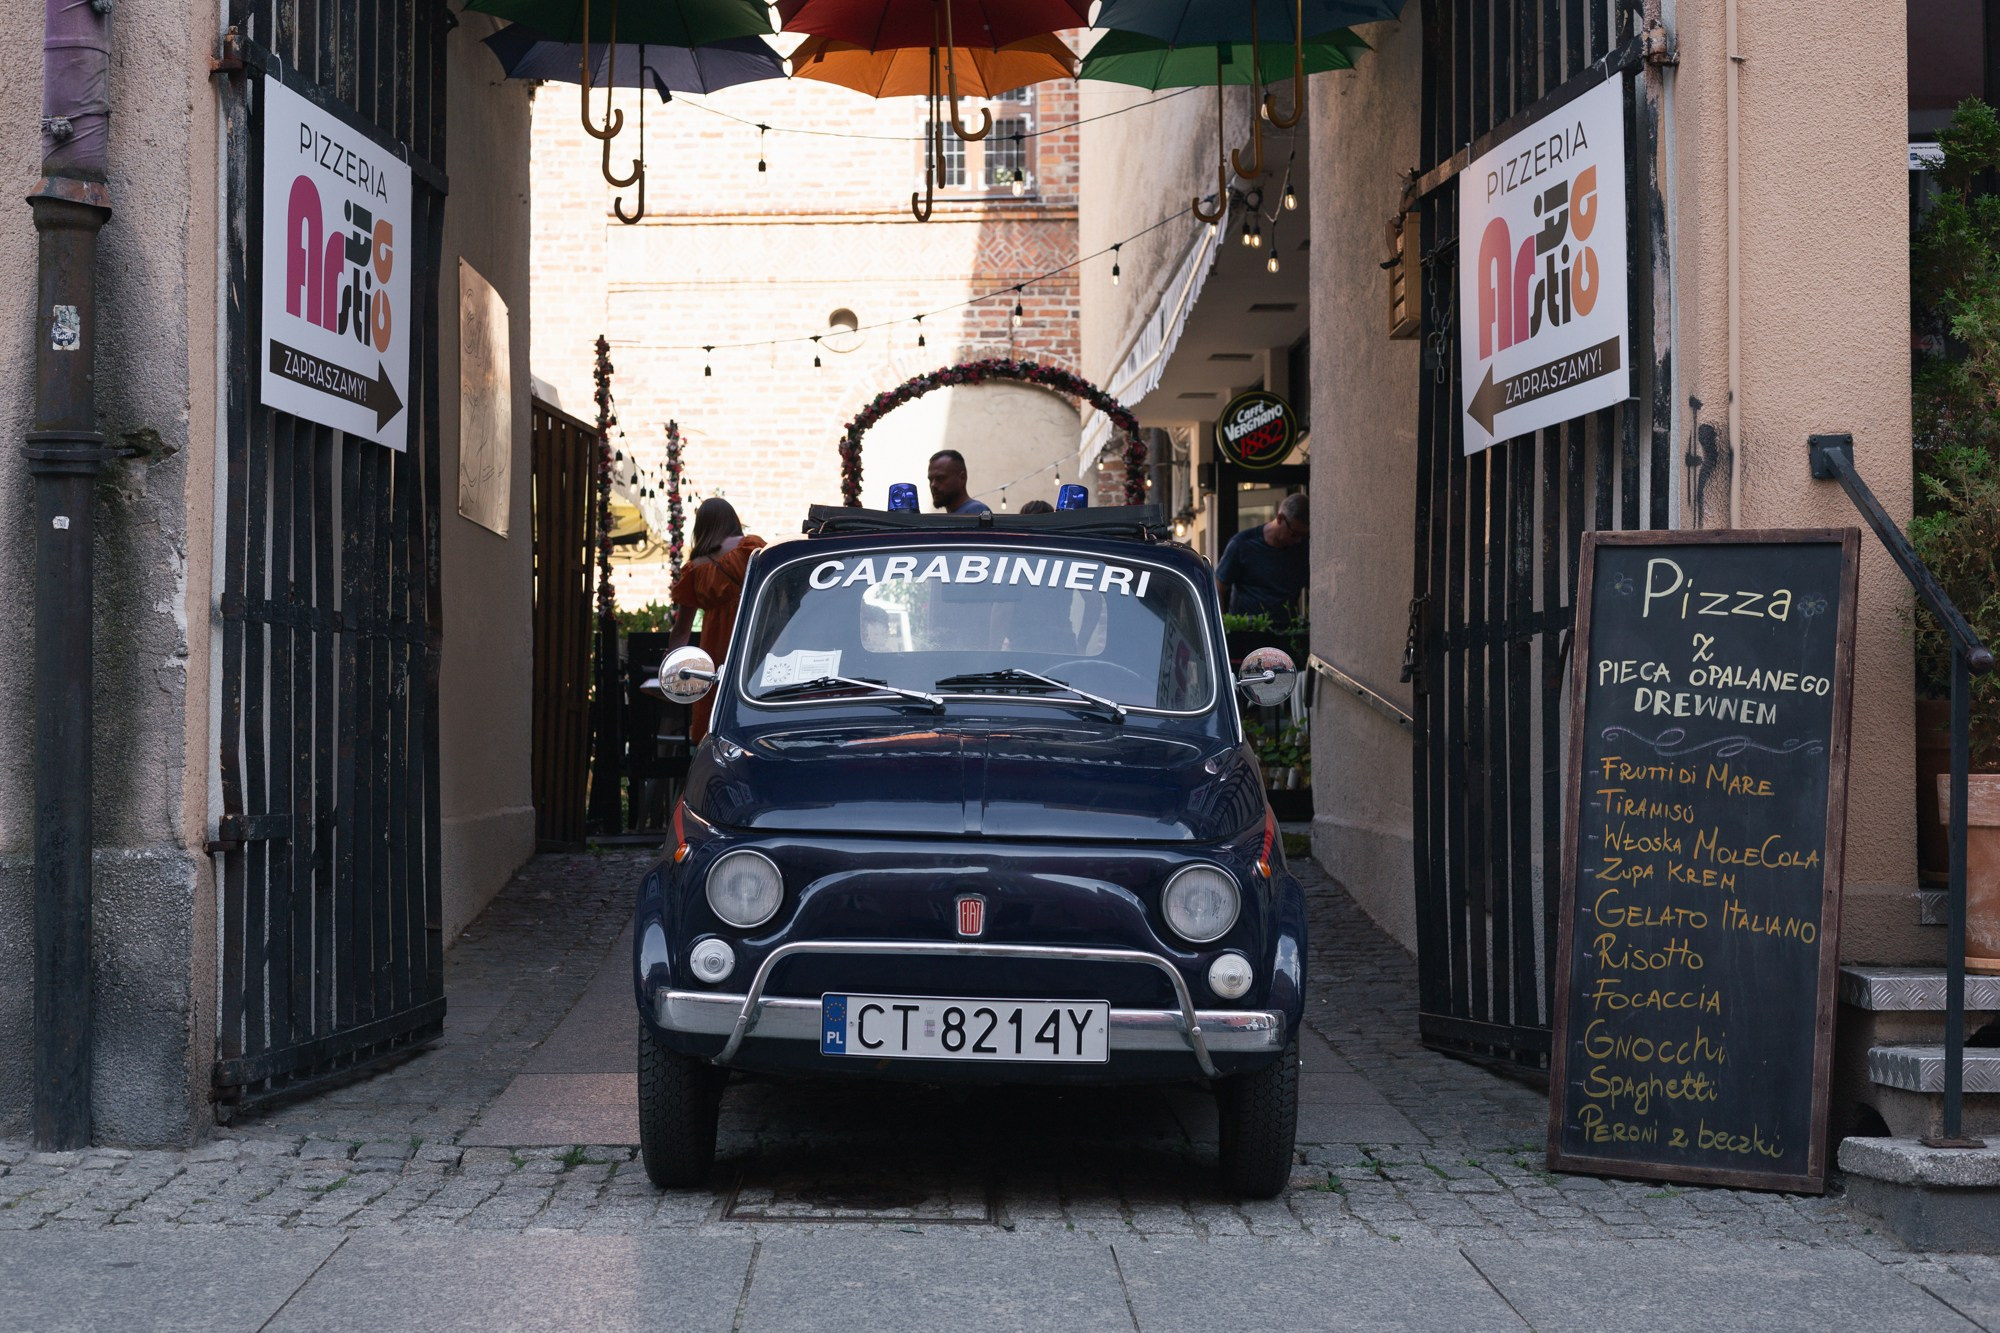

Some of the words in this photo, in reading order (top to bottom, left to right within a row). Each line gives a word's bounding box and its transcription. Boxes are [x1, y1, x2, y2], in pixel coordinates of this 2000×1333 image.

[299, 121, 388, 204] PIZZERIA
[1487, 120, 1588, 204] PIZZERIA
[284, 349, 367, 403] ZAPRASZAMY!
[1505, 347, 1603, 405] ZAPRASZAMY!
[1240, 418, 1284, 460] 1882
[808, 554, 1151, 598] CARABINIERI
[1642, 557, 1792, 622] Pizza
[1598, 659, 1671, 687] PIECA
[1688, 665, 1830, 697] OPALANEGO
[1634, 687, 1777, 725] DREWNEM
[961, 900, 981, 934] FIAT
[827, 1030, 843, 1045] PL
[858, 1003, 919, 1051] CT
[941, 1006, 1093, 1056] 8214Y
[1697, 1117, 1784, 1158] beczki
